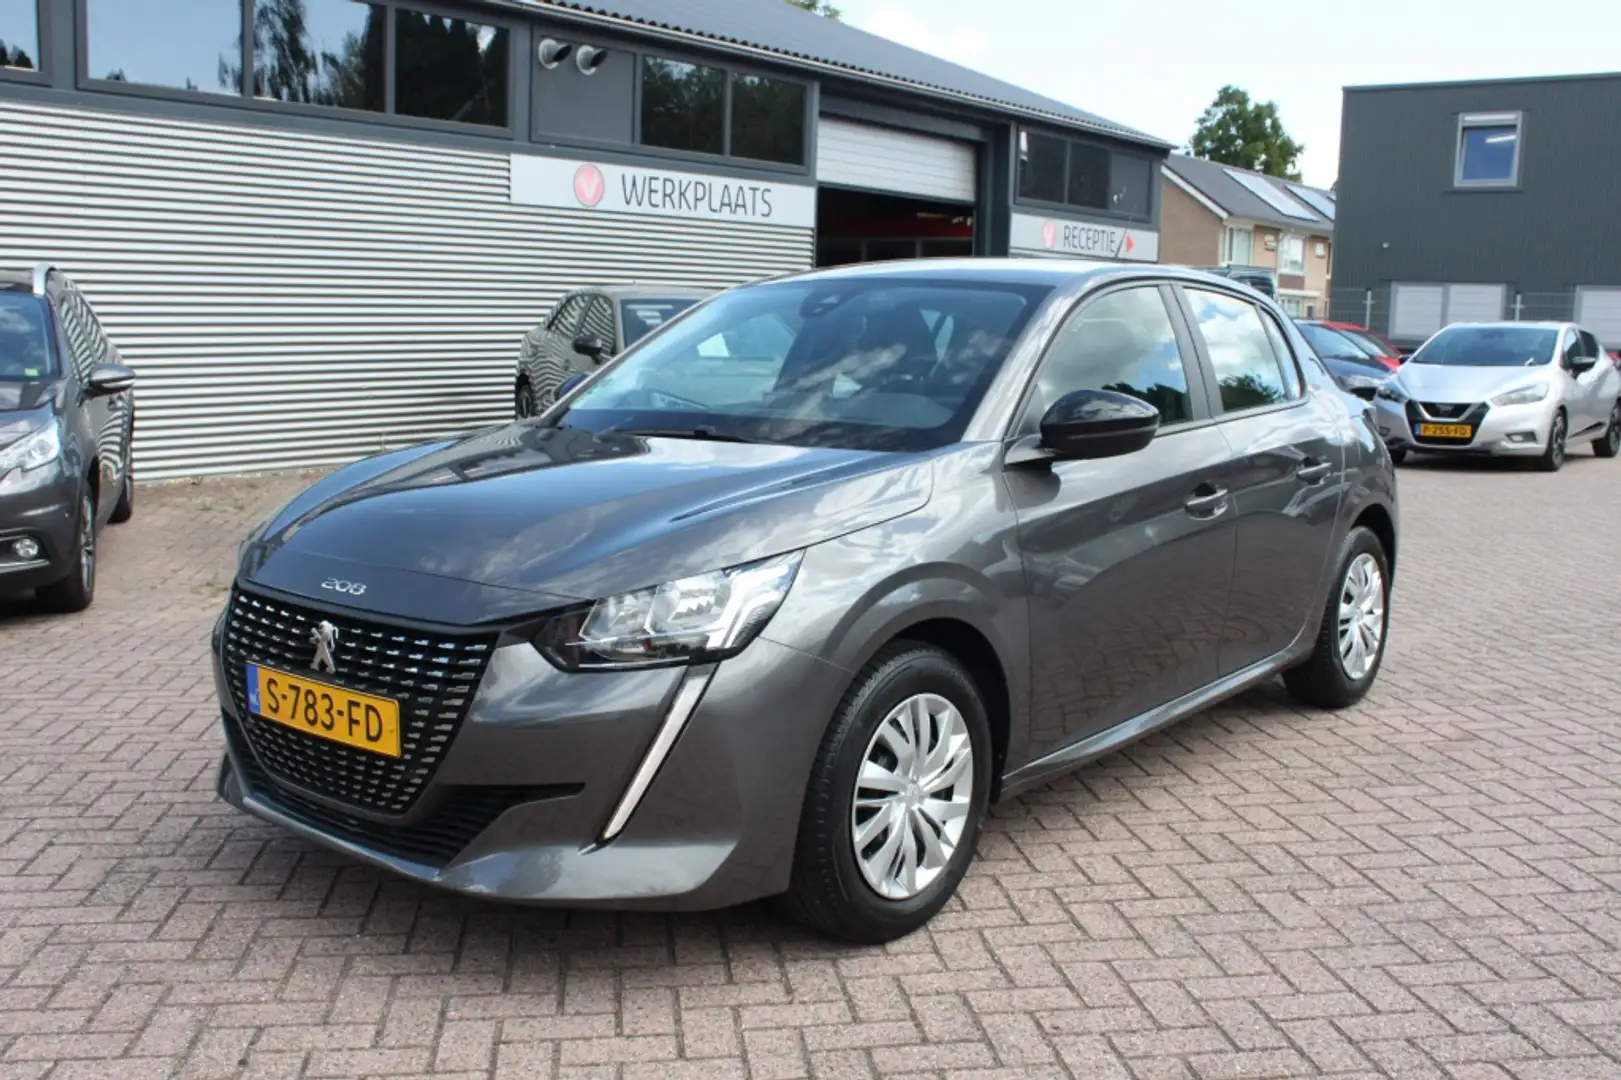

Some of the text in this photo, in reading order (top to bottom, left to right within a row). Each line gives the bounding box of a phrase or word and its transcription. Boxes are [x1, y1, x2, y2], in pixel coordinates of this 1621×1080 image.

[620, 172, 773, 217] WERKPLAATS
[1063, 224, 1116, 253] RECEPTIE
[320, 578, 367, 595] 208
[266, 678, 383, 742] S-783-FD
